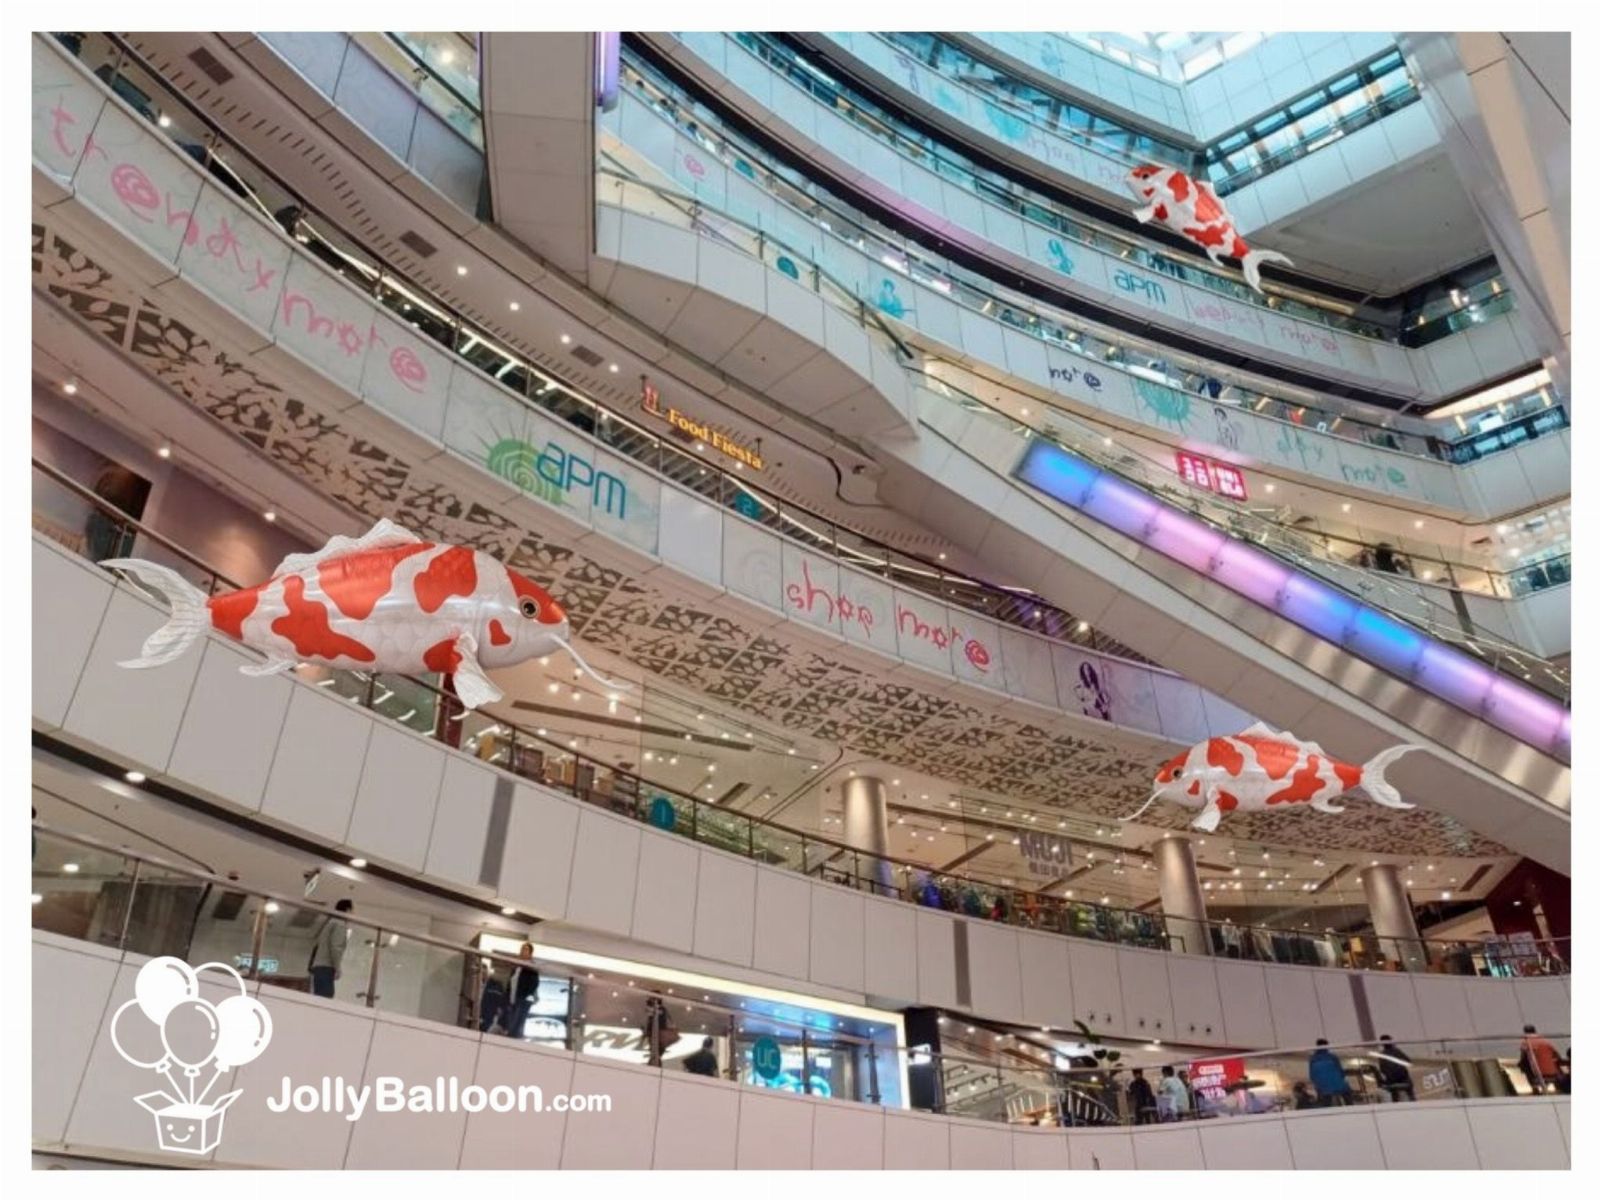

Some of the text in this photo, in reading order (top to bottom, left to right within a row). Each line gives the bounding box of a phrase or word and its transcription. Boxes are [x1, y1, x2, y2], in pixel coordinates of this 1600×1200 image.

[1113, 268, 1167, 305] apm
[668, 408, 762, 470] Food Fiesta
[536, 441, 627, 520] apm
